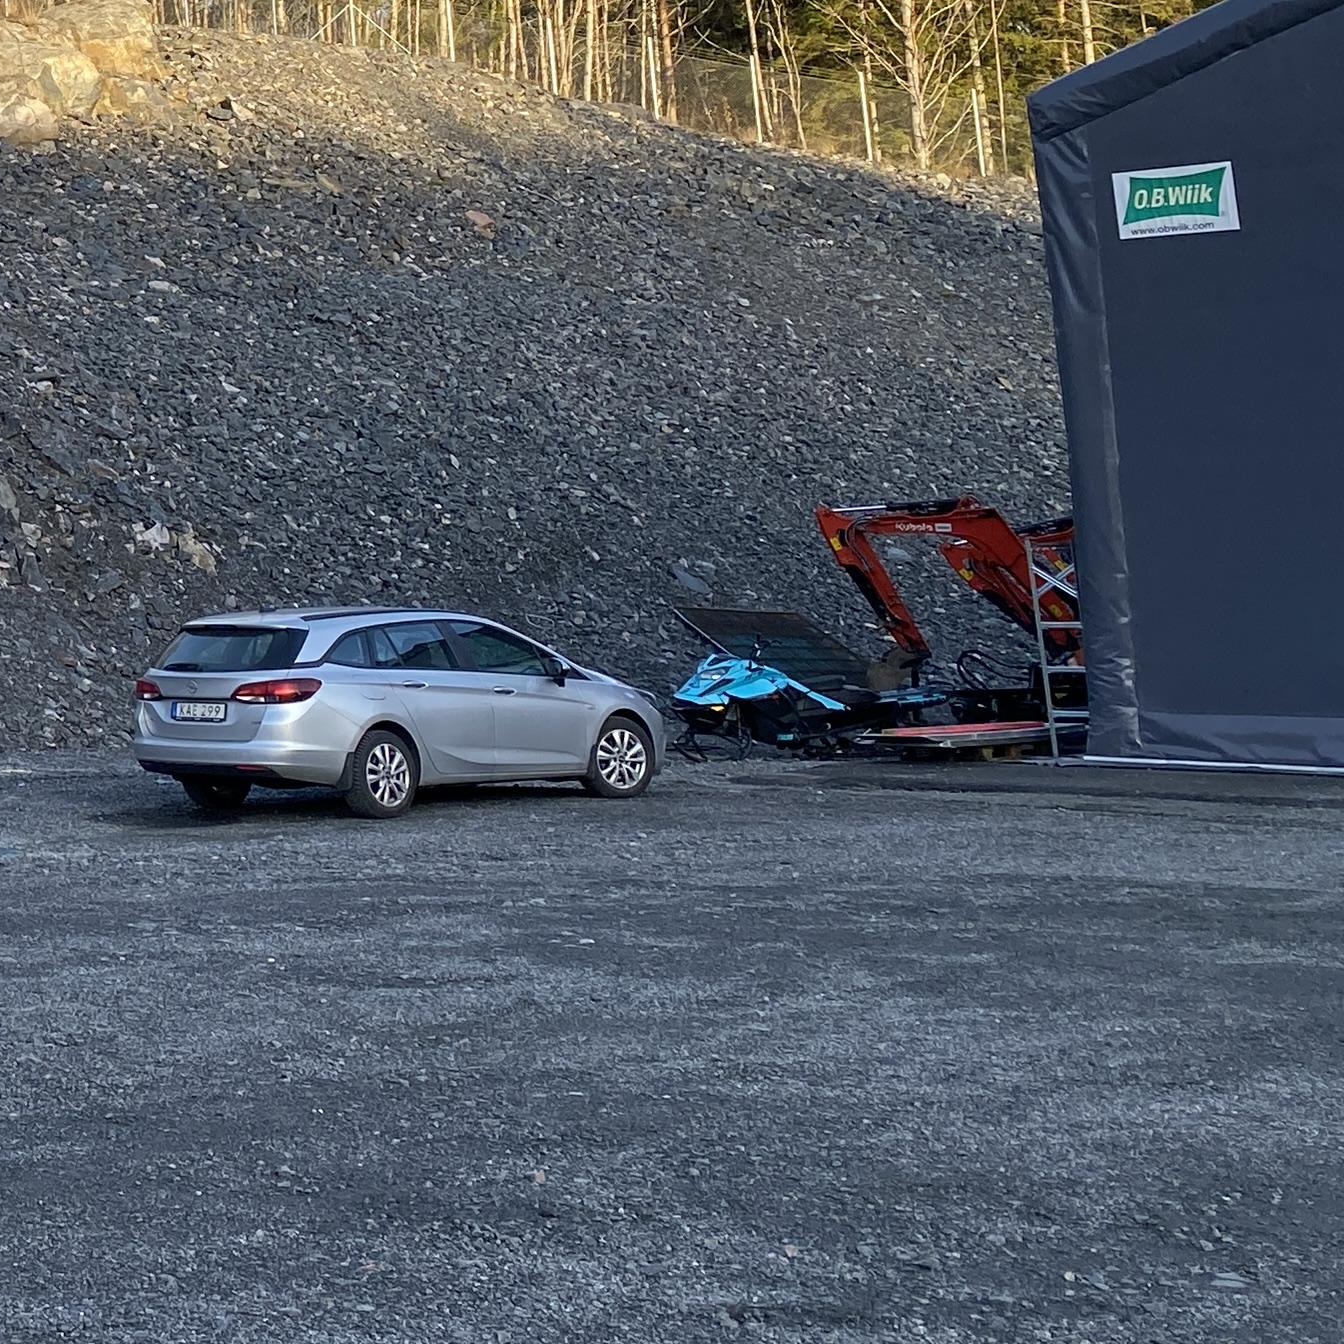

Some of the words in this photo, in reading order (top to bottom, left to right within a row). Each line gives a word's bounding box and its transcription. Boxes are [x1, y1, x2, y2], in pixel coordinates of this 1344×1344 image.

[1134, 184, 1213, 209] O.B.Wiik
[1131, 222, 1215, 235] www.obwiik.com
[201, 704, 222, 718] 299
